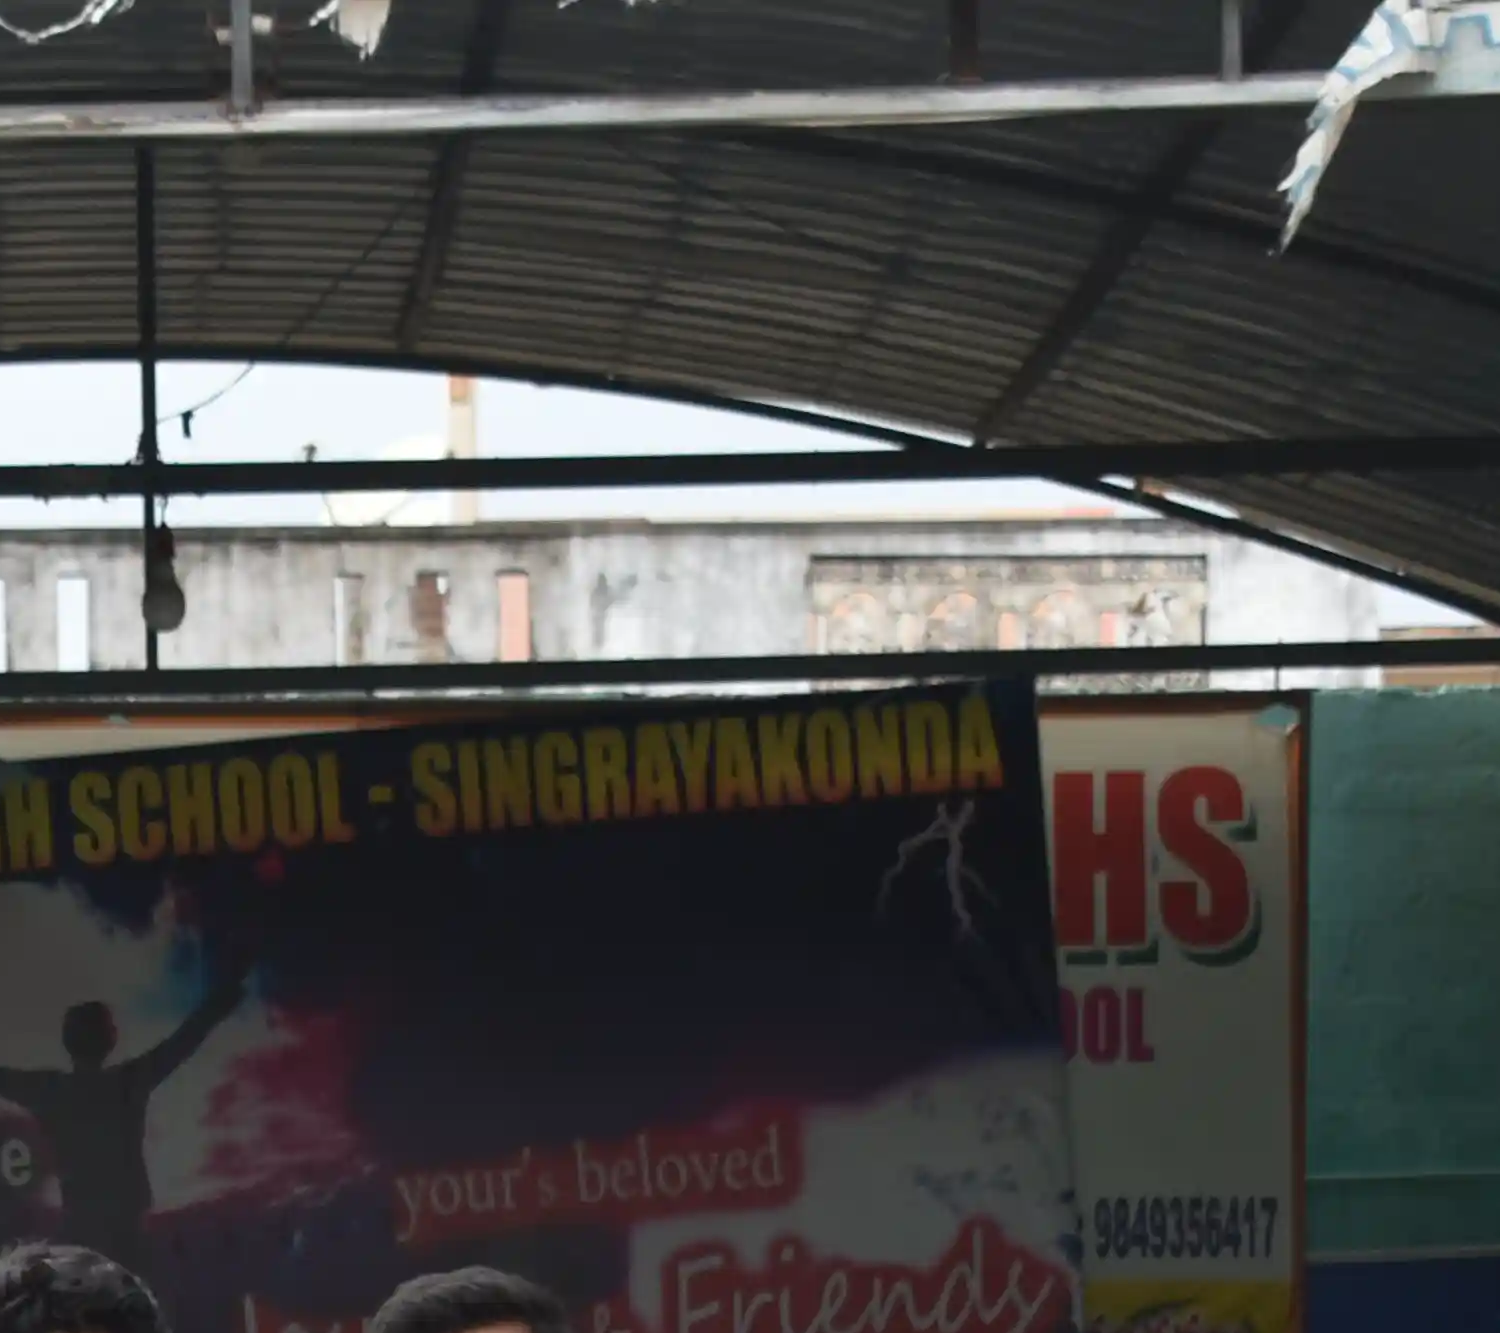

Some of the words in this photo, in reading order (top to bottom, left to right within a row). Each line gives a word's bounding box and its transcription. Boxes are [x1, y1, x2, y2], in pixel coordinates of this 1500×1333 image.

[72, 751, 355, 866] SCHOOL
[410, 696, 1002, 836] SINGRAYAKONDA
[1053, 766, 1262, 966] HS
[575, 1121, 784, 1203] beloved
[1094, 1195, 1278, 1258] 9849356417
